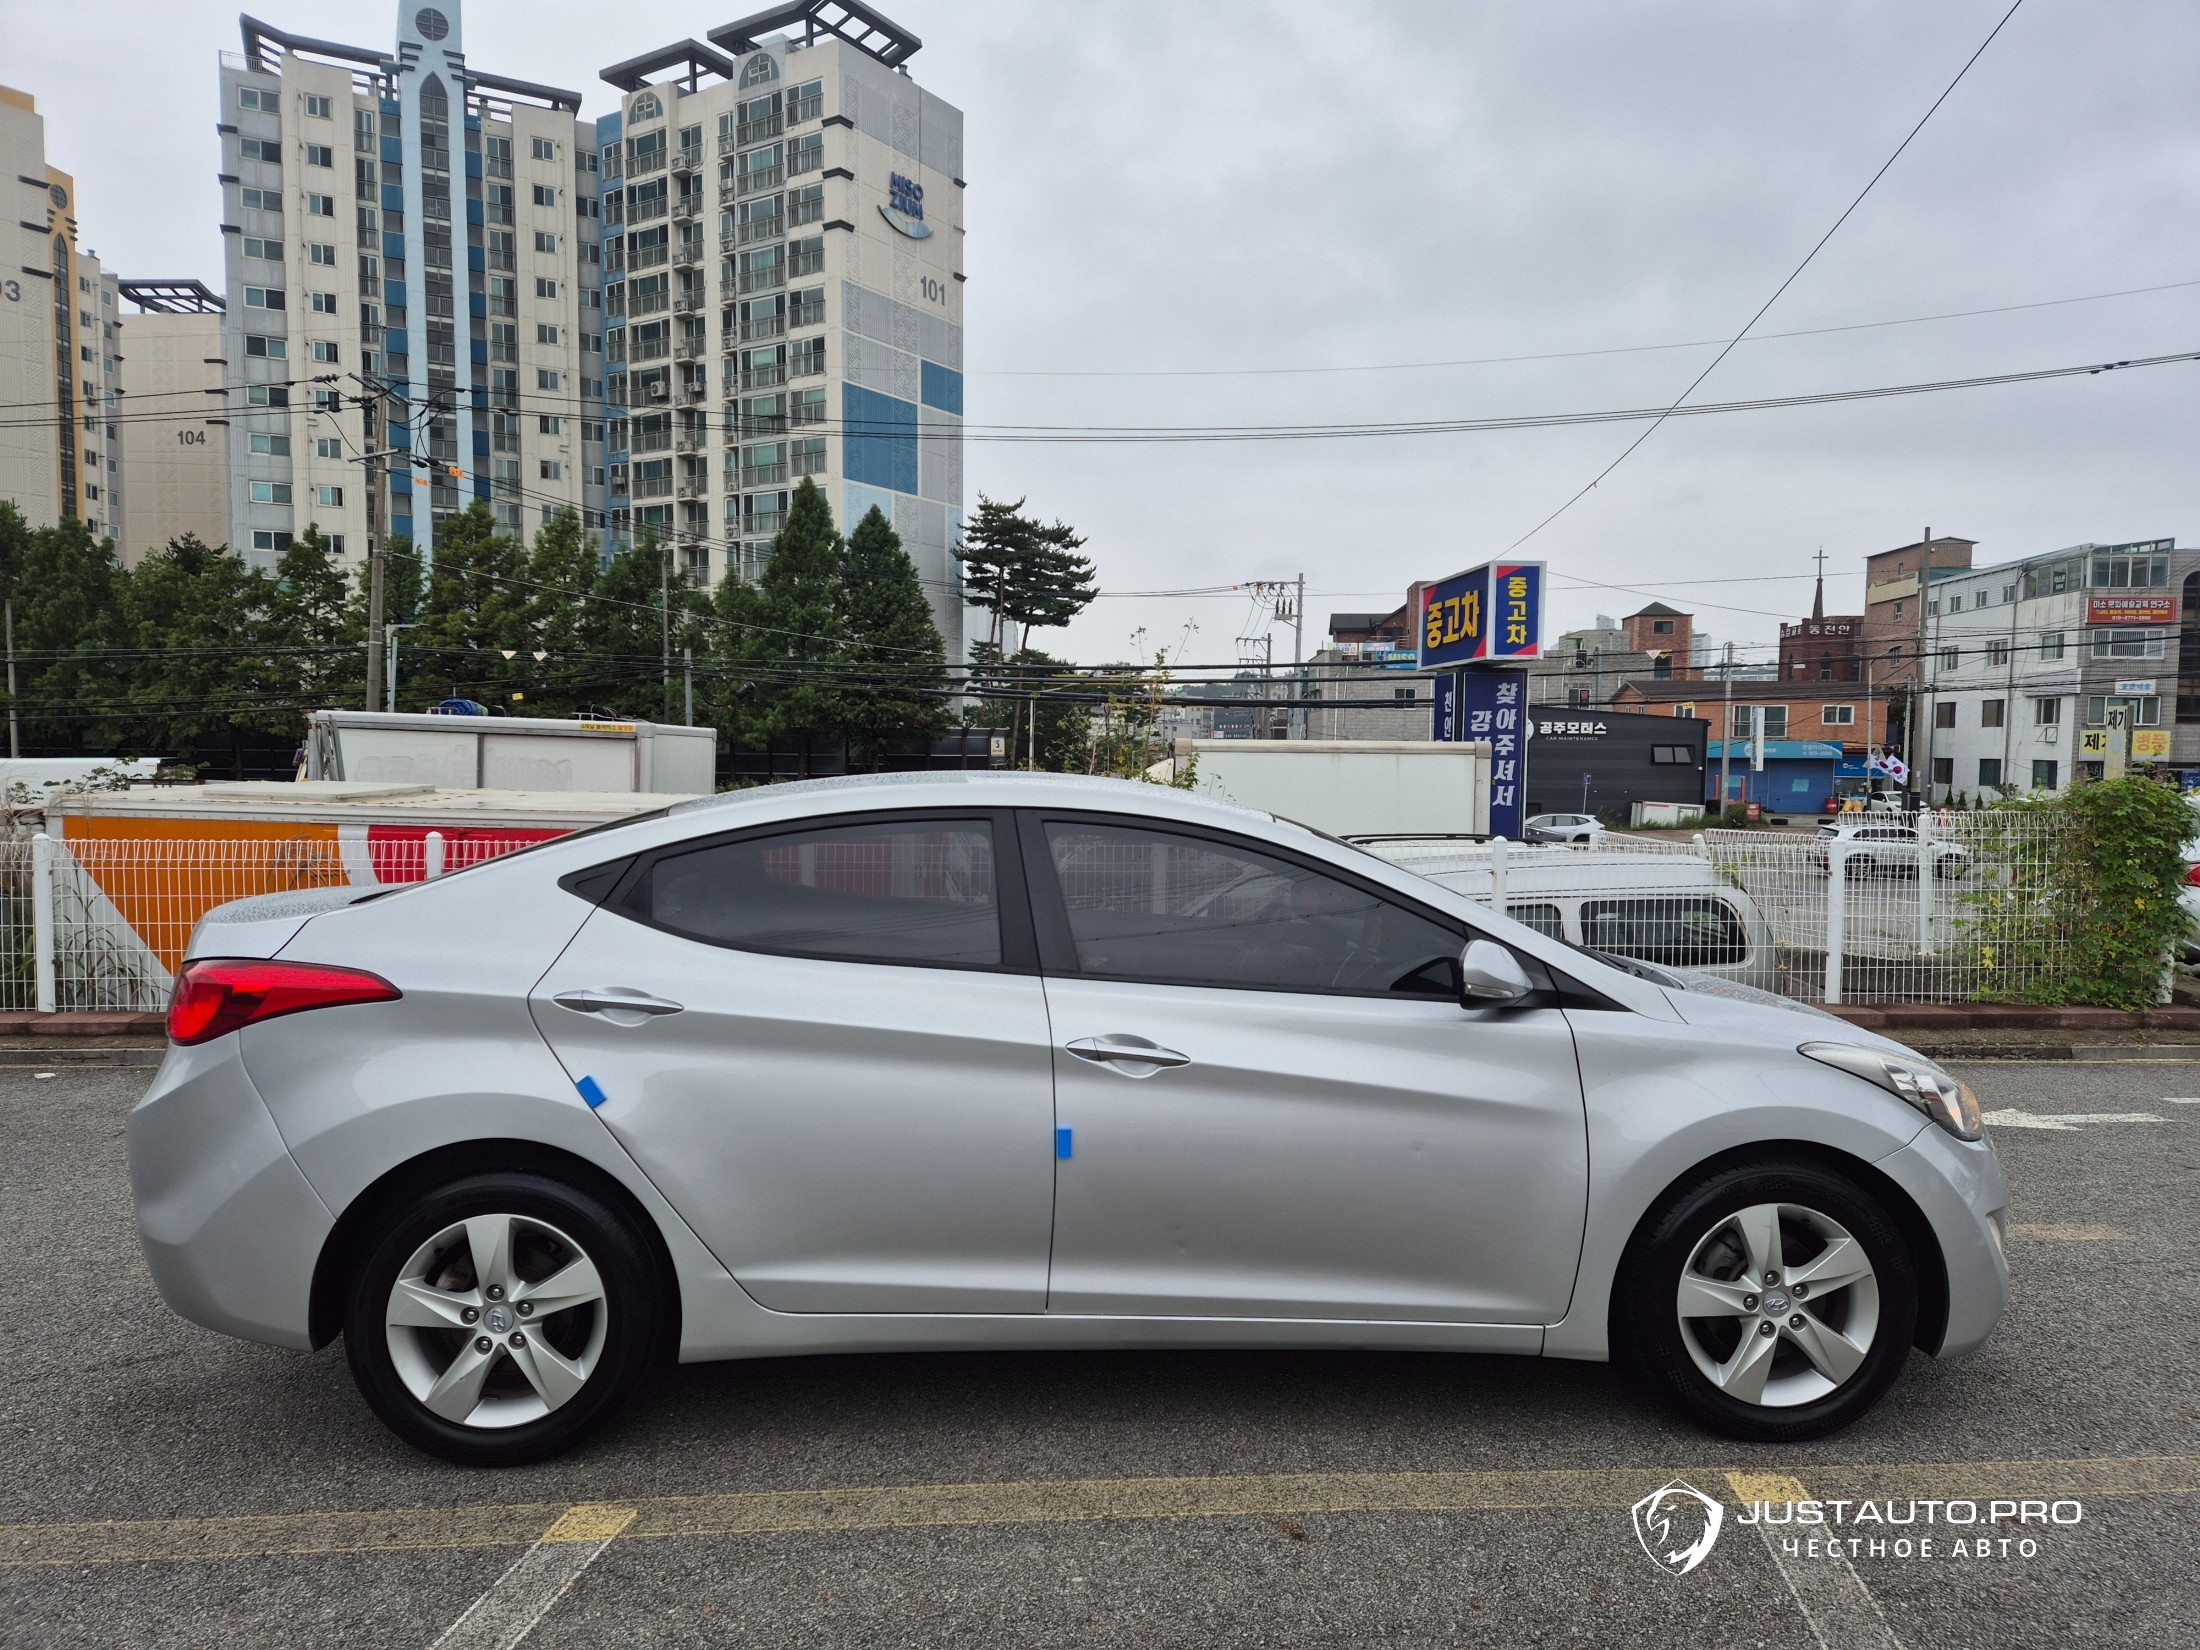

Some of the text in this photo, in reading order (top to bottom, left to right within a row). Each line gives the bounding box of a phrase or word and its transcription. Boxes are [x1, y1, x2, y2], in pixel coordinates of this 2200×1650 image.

[0, 279, 21, 302] 3
[920, 275, 945, 306] 101
[177, 430, 206, 445] 104
[1426, 589, 1480, 649] 중고차
[1506, 576, 1528, 645] 중고차
[1540, 721, 1607, 735] 공주모터스
[2107, 709, 2127, 731] 제기
[1491, 682, 1518, 807] 찾아주셔서
